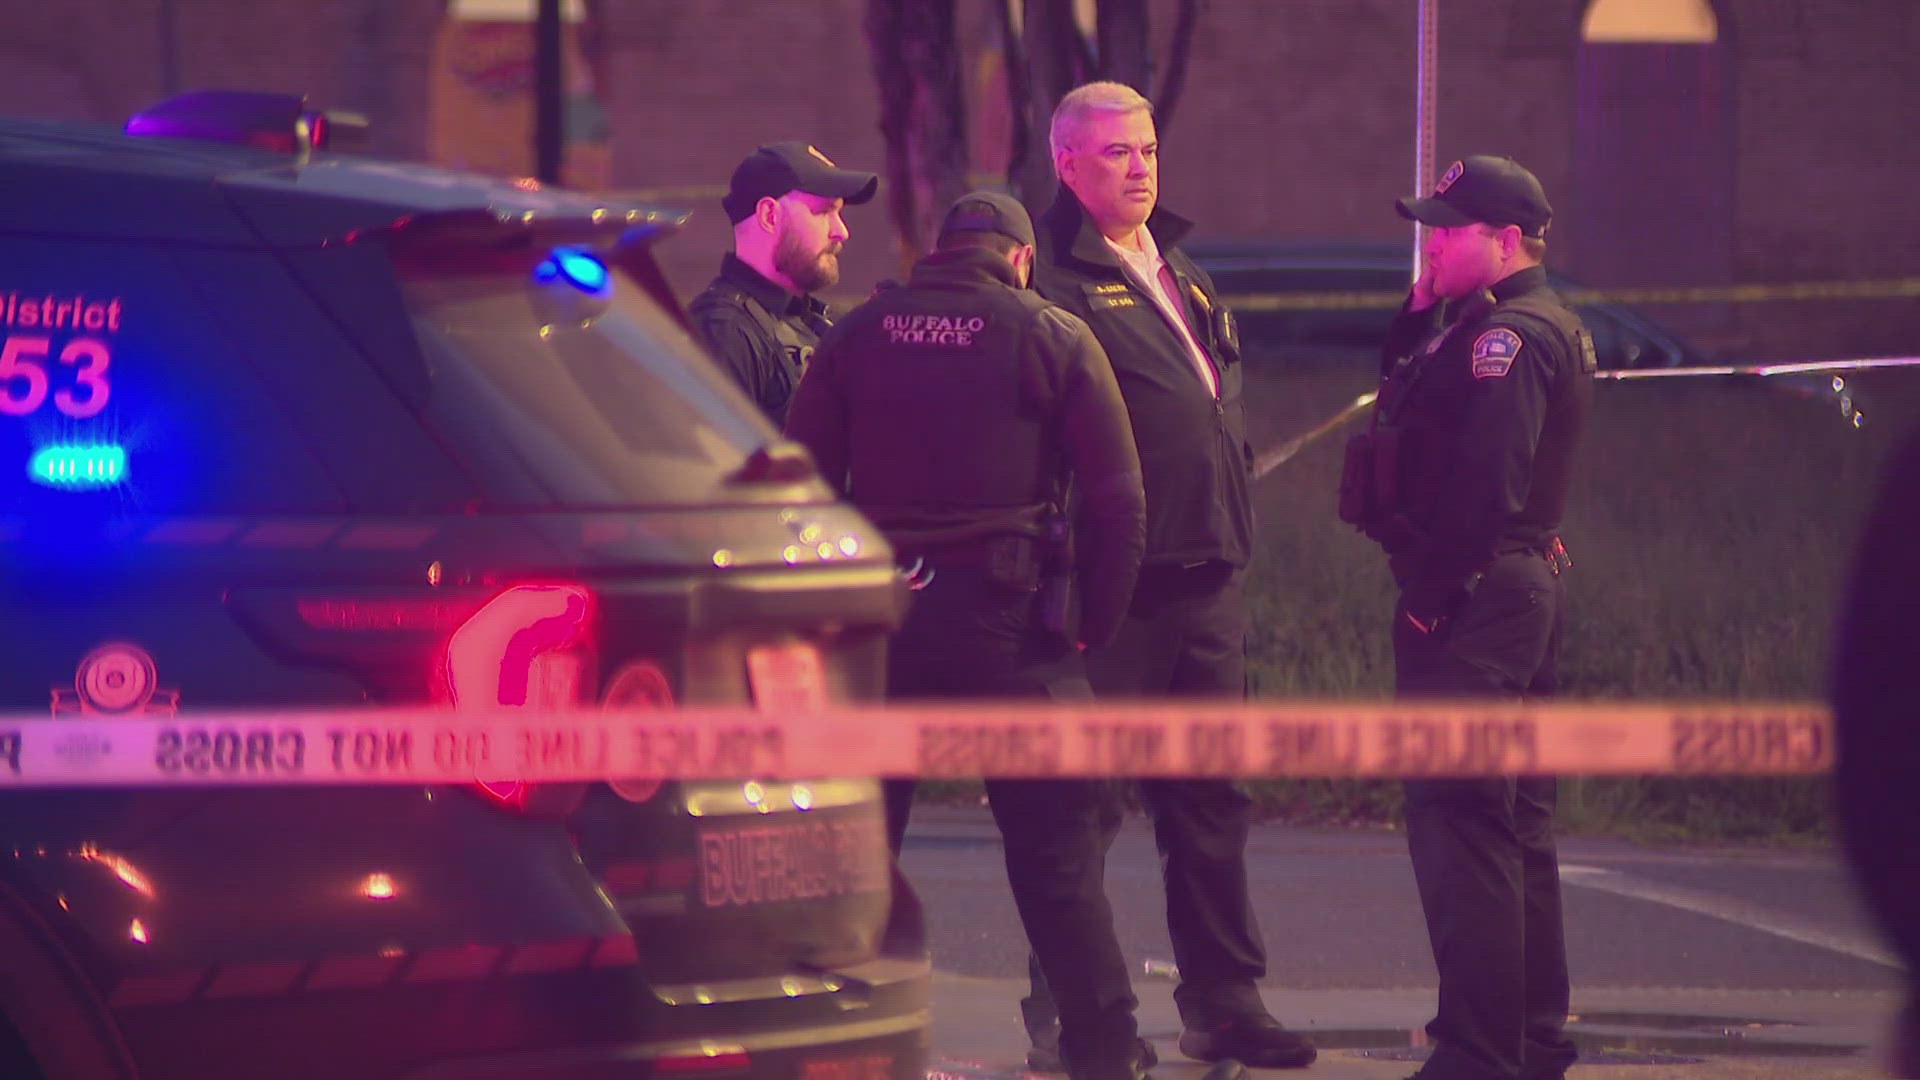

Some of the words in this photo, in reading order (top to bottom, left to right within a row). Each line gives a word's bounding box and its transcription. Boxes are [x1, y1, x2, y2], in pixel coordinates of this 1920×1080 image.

[0, 292, 121, 331] istrict
[883, 315, 984, 332] BUFFALO
[890, 330, 972, 346] POLICE
